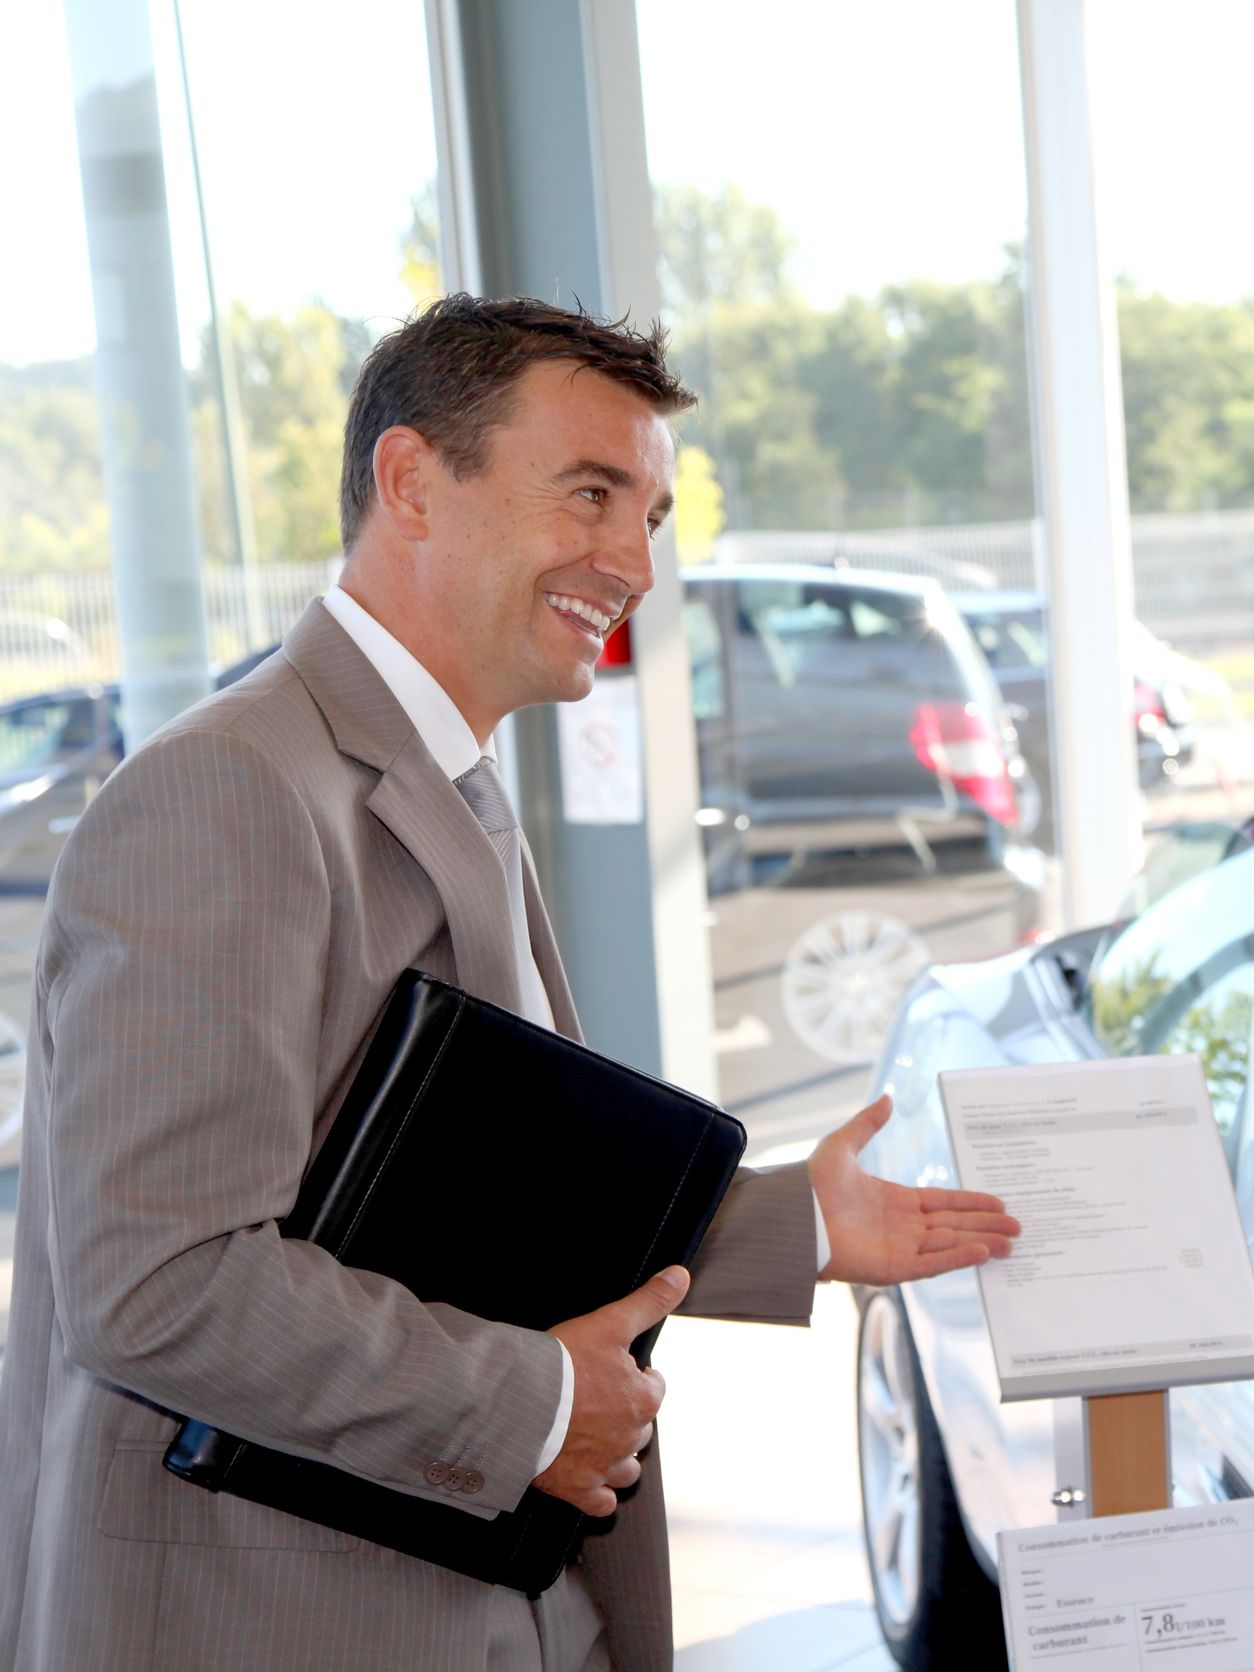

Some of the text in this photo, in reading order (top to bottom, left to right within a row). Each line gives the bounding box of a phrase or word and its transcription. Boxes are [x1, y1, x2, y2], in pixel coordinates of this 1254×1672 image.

[1018, 1536, 1088, 1553] Consommation
[1091, 1533, 1102, 1543] de
[1104, 1526, 1150, 1542] carburant
[1152, 1526, 1162, 1534] et
[1207, 1518, 1218, 1528] de
[1056, 1597, 1094, 1609] Essence
[1028, 1614, 1126, 1636] Consommation de
[1208, 1616, 1226, 1628] km
[1033, 1635, 1088, 1651] carburant
